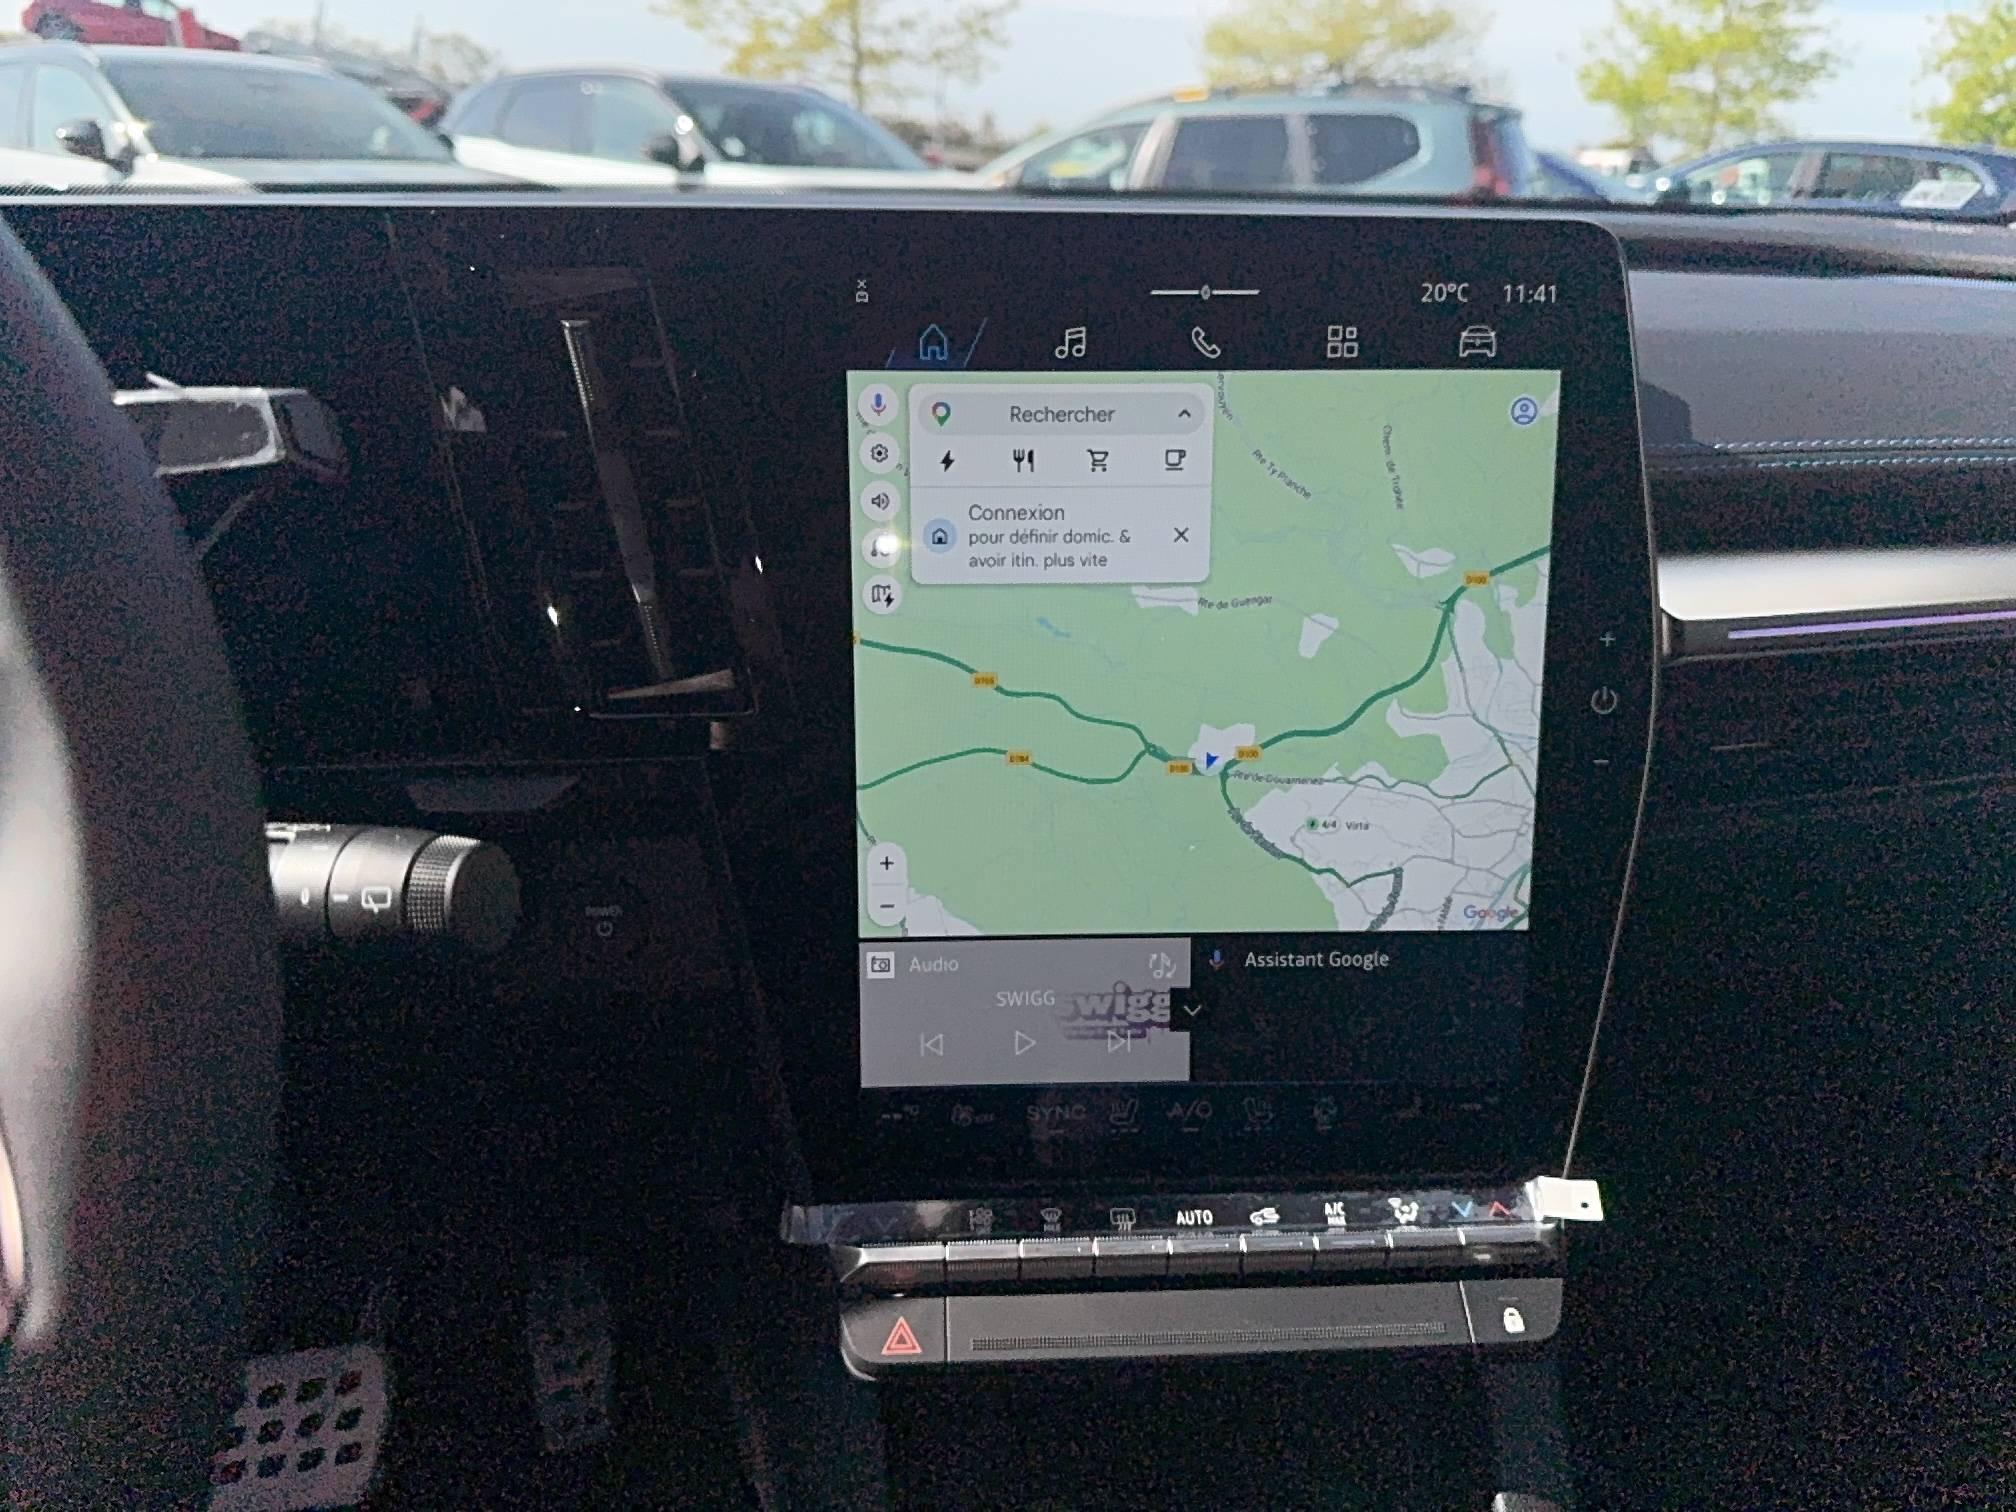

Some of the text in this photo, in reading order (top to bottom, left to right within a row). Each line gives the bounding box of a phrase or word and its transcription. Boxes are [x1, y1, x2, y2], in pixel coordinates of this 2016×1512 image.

[1421, 283, 1469, 303] 20°C
[1503, 284, 1557, 303] 11:41
[1010, 406, 1116, 423] Rechercher
[1252, 449, 1312, 500] Rte Ty Planche
[968, 504, 1065, 521] Connexion
[968, 529, 1131, 547] pour définir domic. &
[968, 553, 1108, 570] avoir itin. plus vite
[1464, 904, 1519, 922] Google
[909, 956, 959, 973] Audio
[1245, 951, 1390, 970] Assistant Google
[996, 990, 1056, 1007] SWIGG
[1026, 1104, 1087, 1122] SYNC
[1176, 1209, 1213, 1226] AUTO
